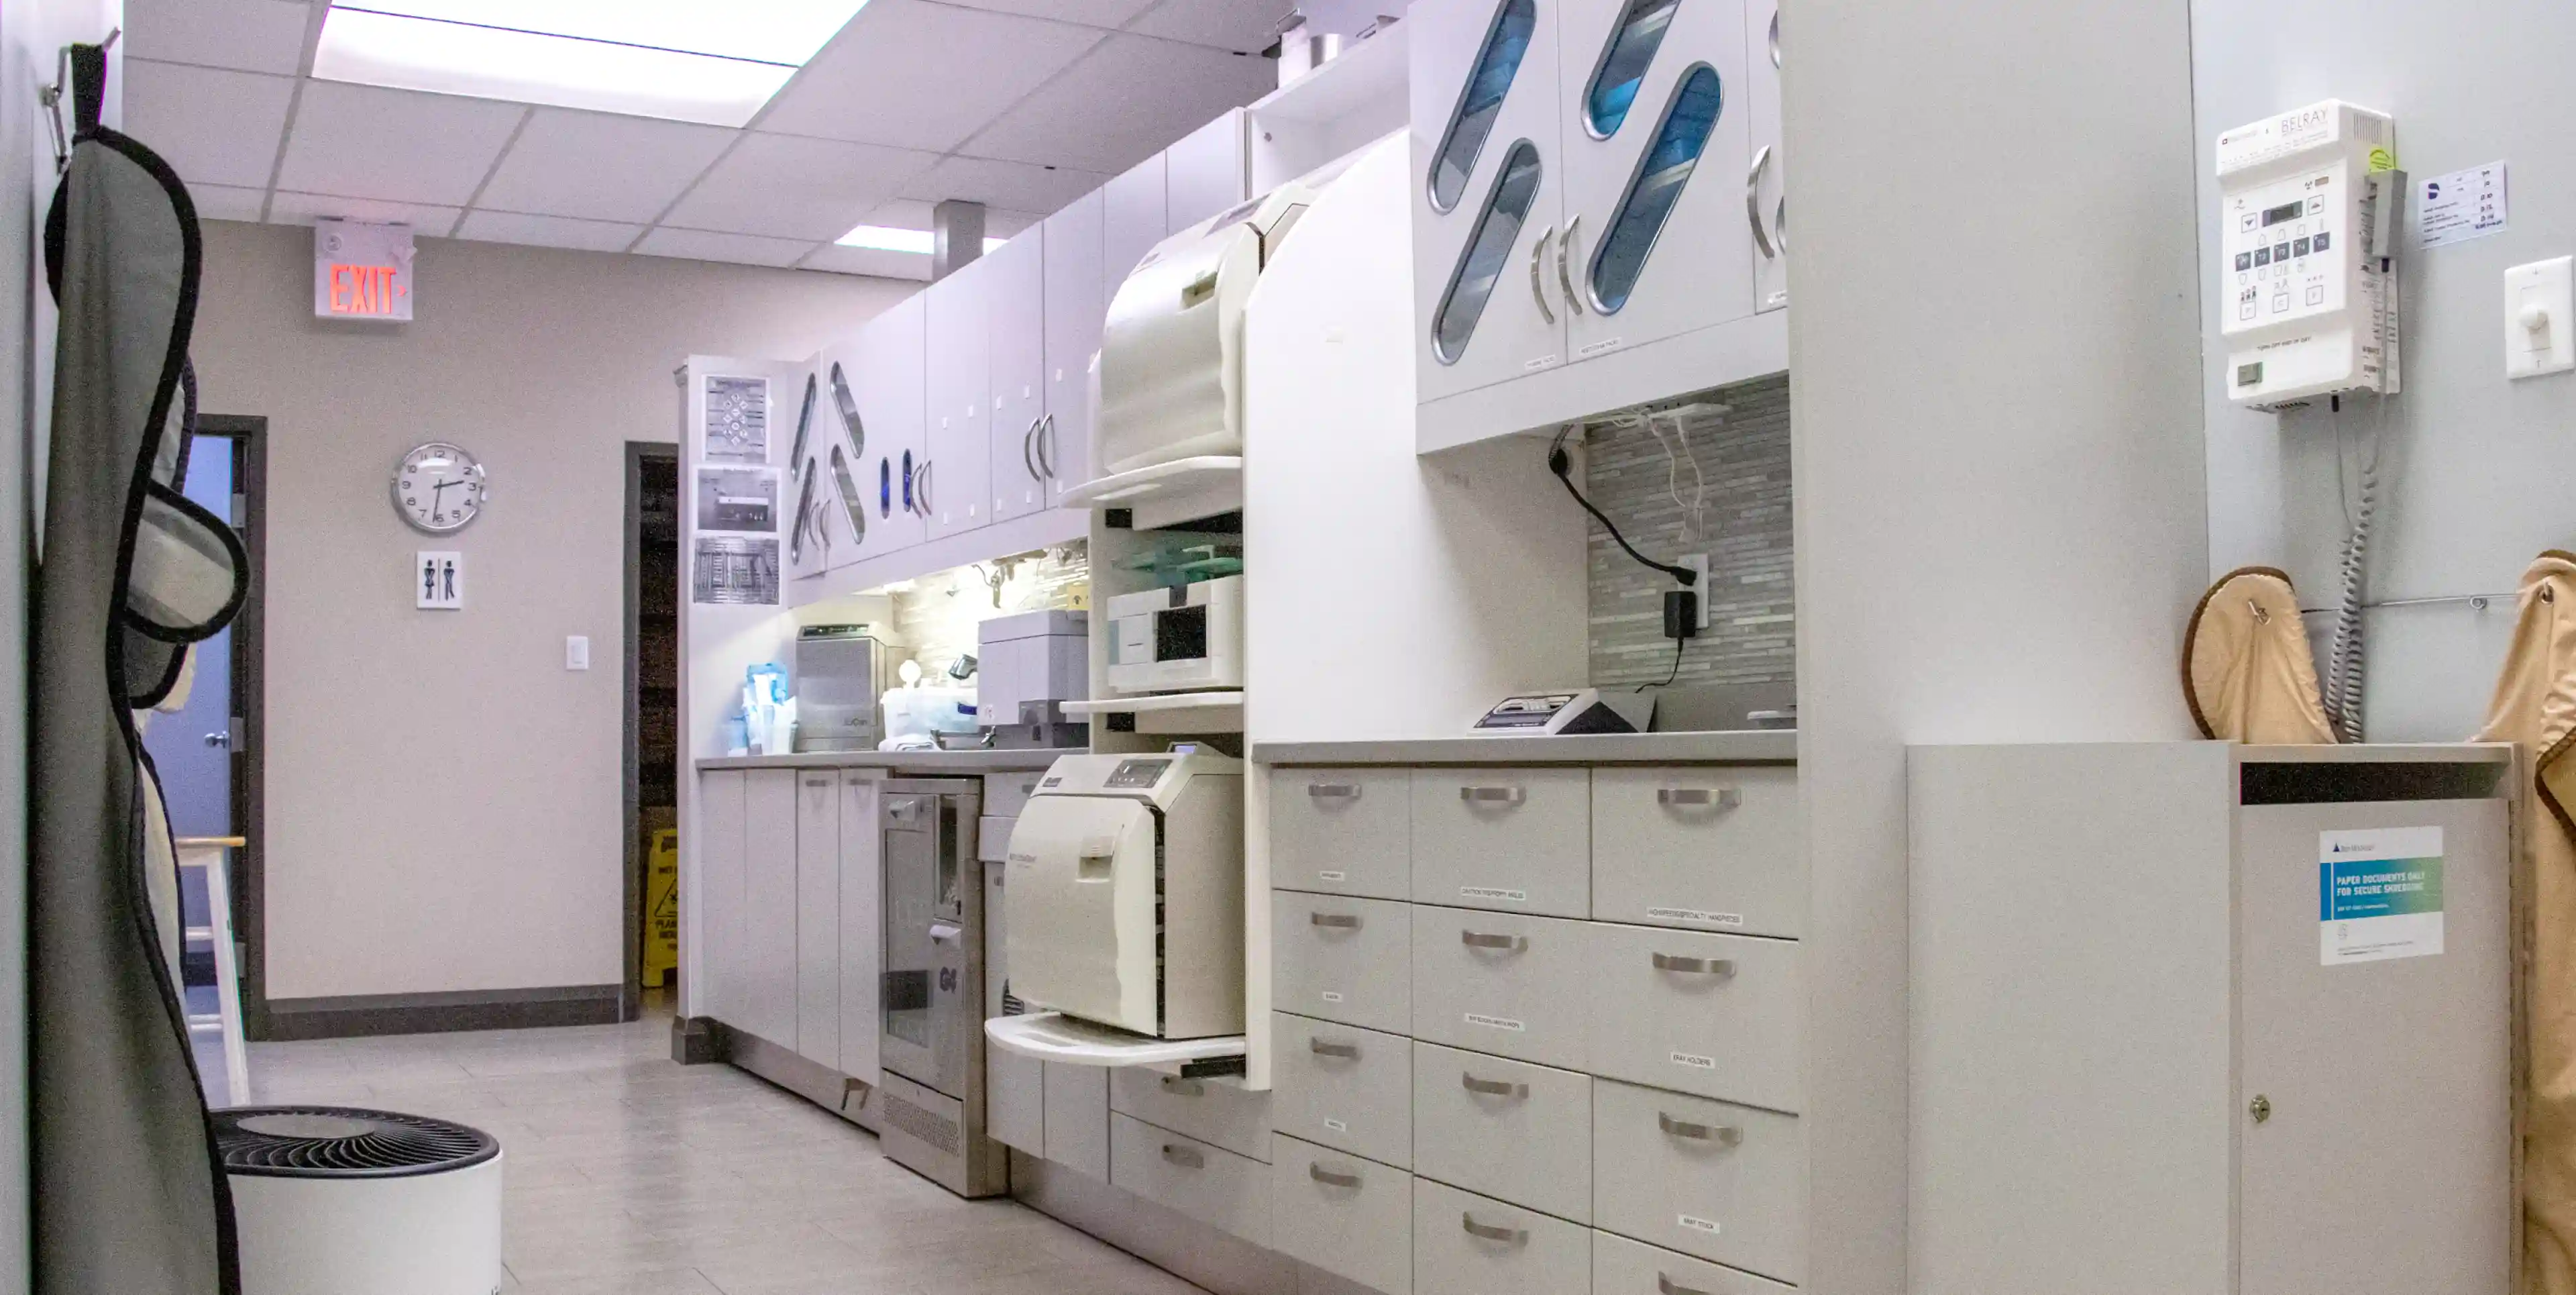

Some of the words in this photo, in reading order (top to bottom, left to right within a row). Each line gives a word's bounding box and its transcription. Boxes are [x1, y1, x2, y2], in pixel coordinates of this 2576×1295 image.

[2282, 107, 2328, 134] BELRAY
[329, 263, 397, 314] EXIT
[435, 450, 445, 458] 12
[407, 464, 417, 474] 10
[464, 467, 472, 475] 2
[402, 480, 411, 489] 9
[468, 482, 477, 491] 3
[407, 497, 416, 506] 8
[419, 509, 427, 517] 7
[435, 513, 444, 522] 6
[451, 510, 461, 518] 5
[2337, 875, 2361, 885] PAPER
[2362, 872, 2406, 884] DOCUMENTS
[2337, 887, 2352, 896] FOR
[2354, 885, 2382, 895] SECURE
